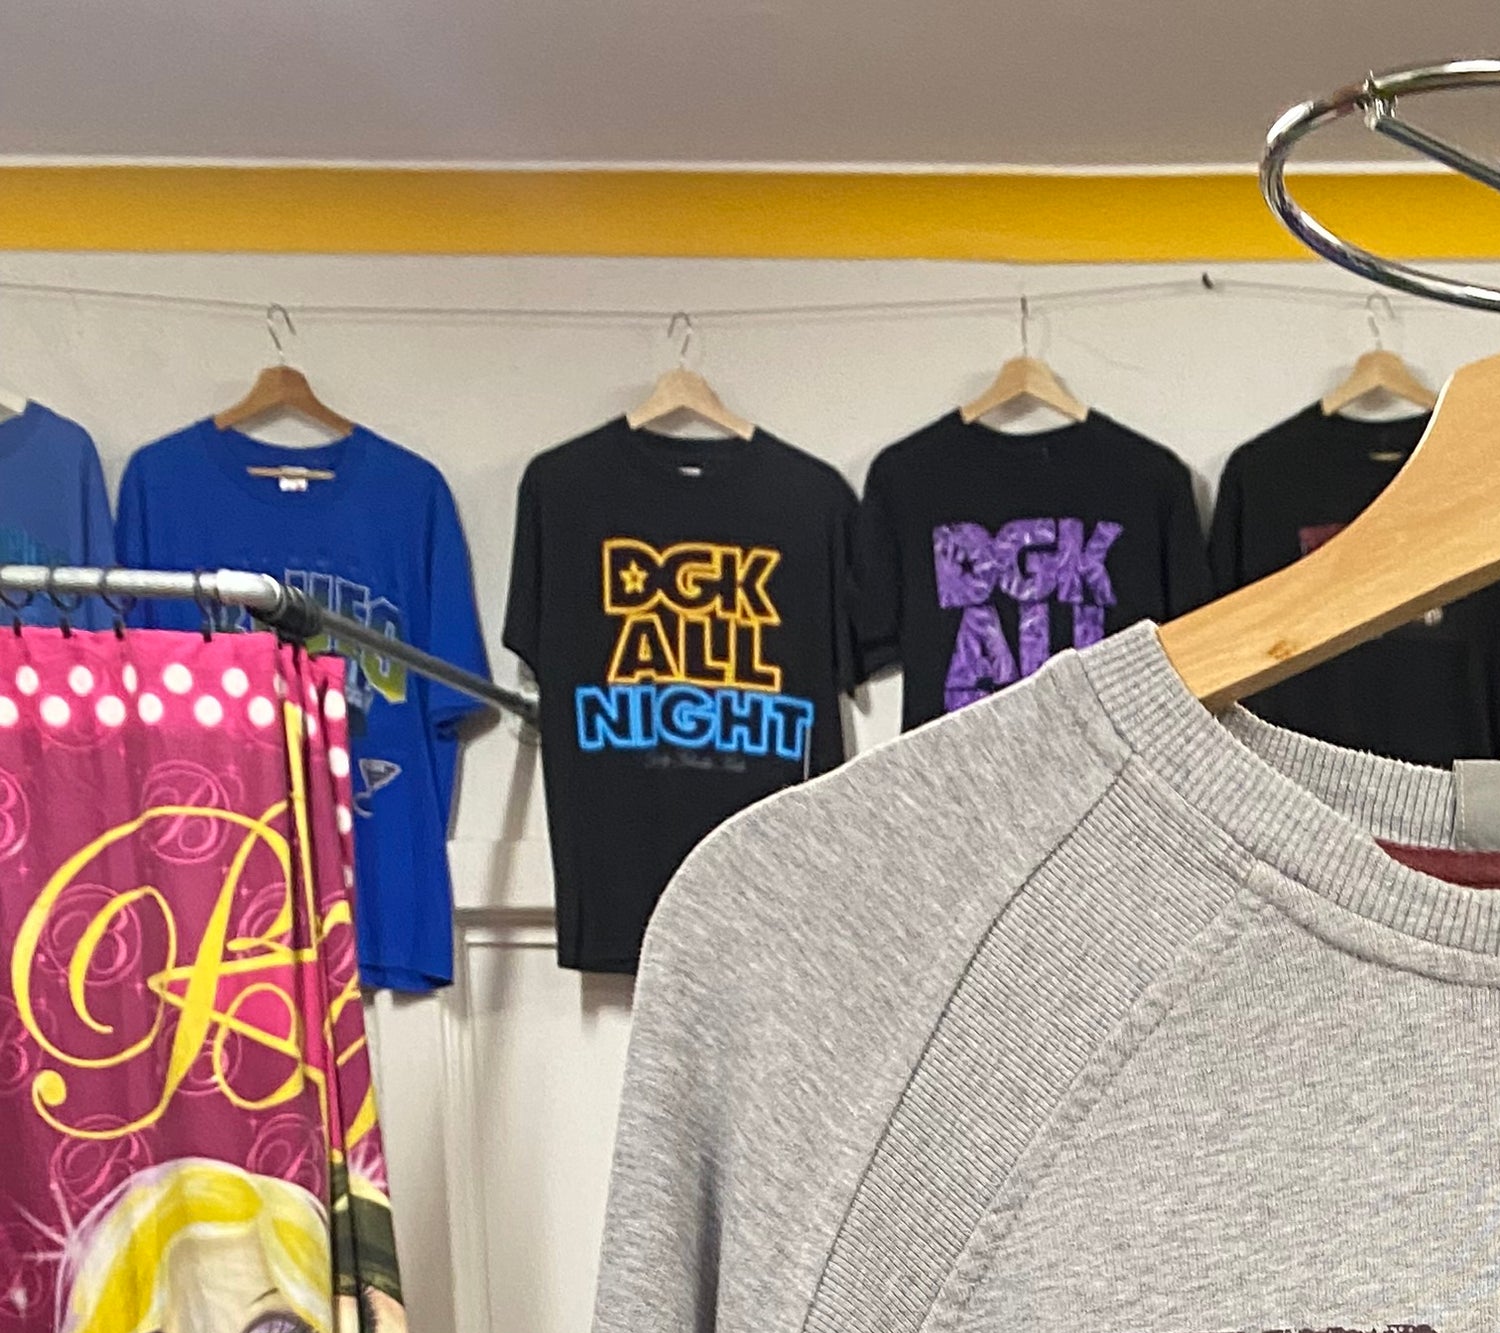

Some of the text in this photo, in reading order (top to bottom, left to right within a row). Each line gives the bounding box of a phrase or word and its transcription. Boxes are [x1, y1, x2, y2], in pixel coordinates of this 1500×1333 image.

[602, 538, 780, 627] DGK
[932, 517, 1124, 609] DGK
[607, 612, 781, 692] ALL
[575, 684, 814, 761] NIGHT
